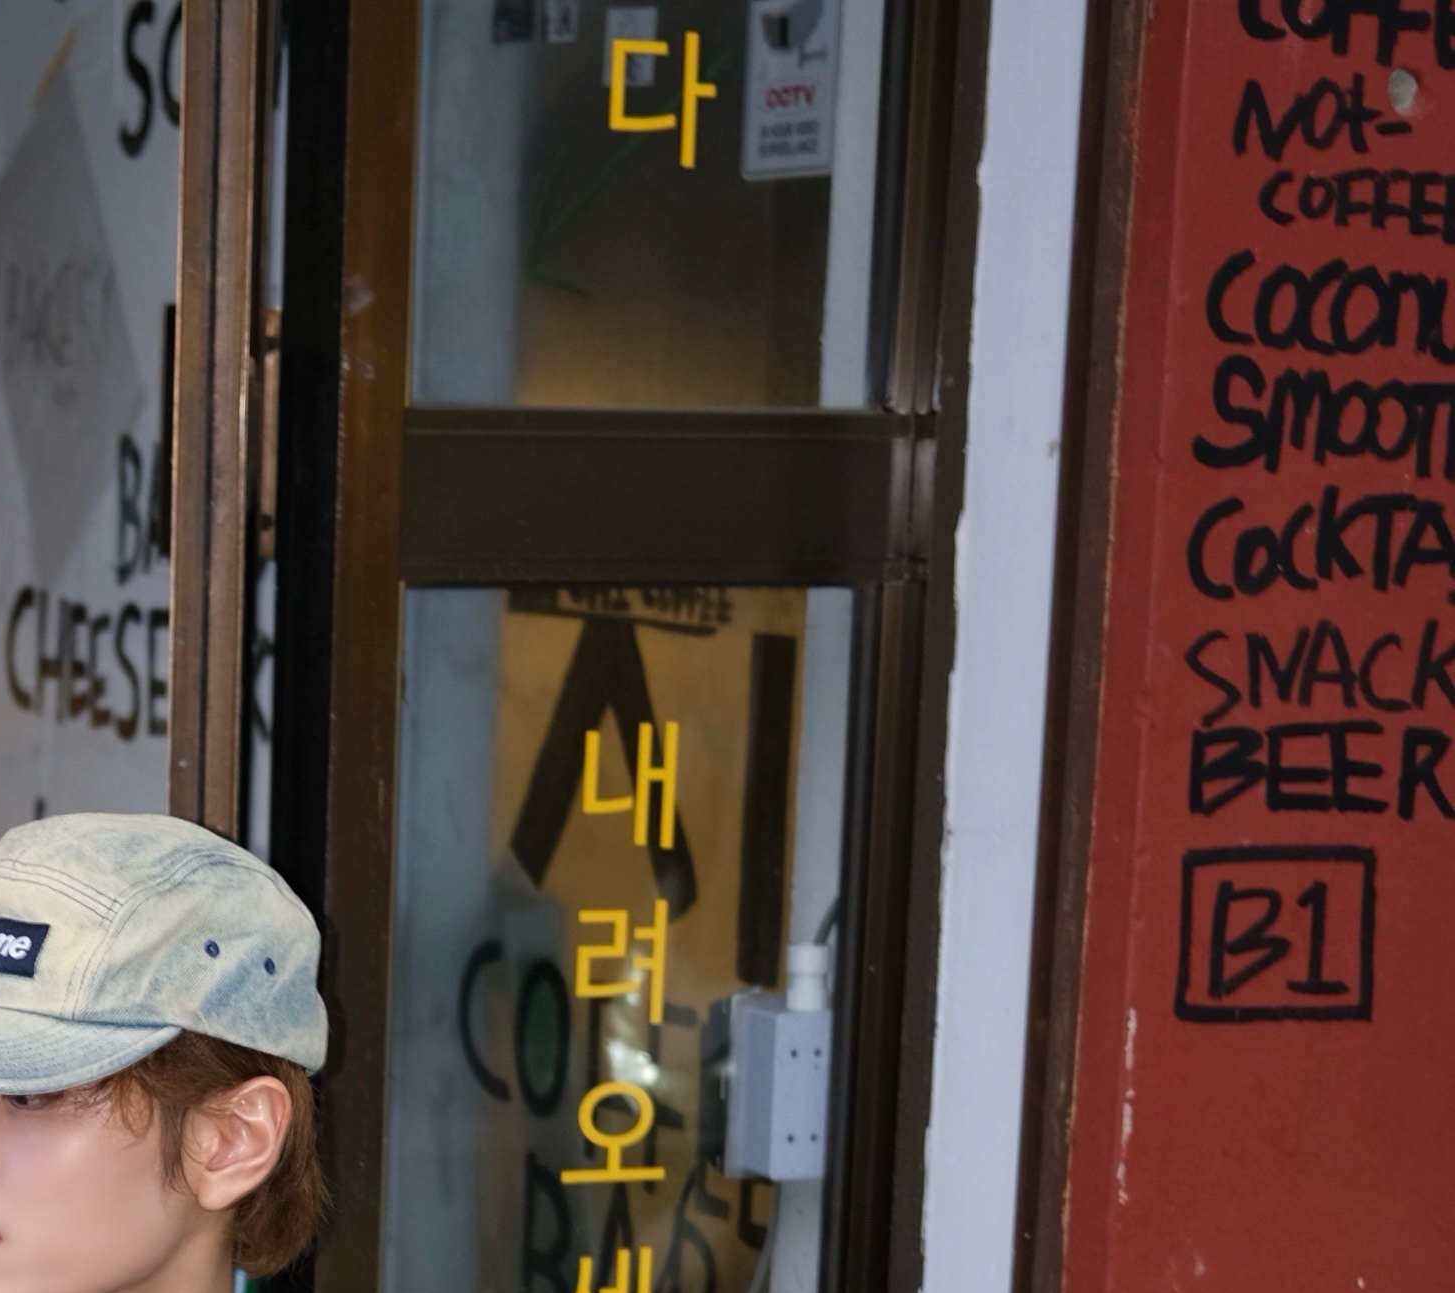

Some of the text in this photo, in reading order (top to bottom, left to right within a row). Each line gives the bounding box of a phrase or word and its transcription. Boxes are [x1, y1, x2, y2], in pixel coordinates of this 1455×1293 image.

[608, 31, 716, 170] 다
[764, 84, 817, 108] CCTV
[1191, 355, 1455, 482] SMOOT
[1185, 619, 1455, 726] SNACK
[1189, 720, 1455, 821] BEER
[1206, 880, 1350, 999] B1
